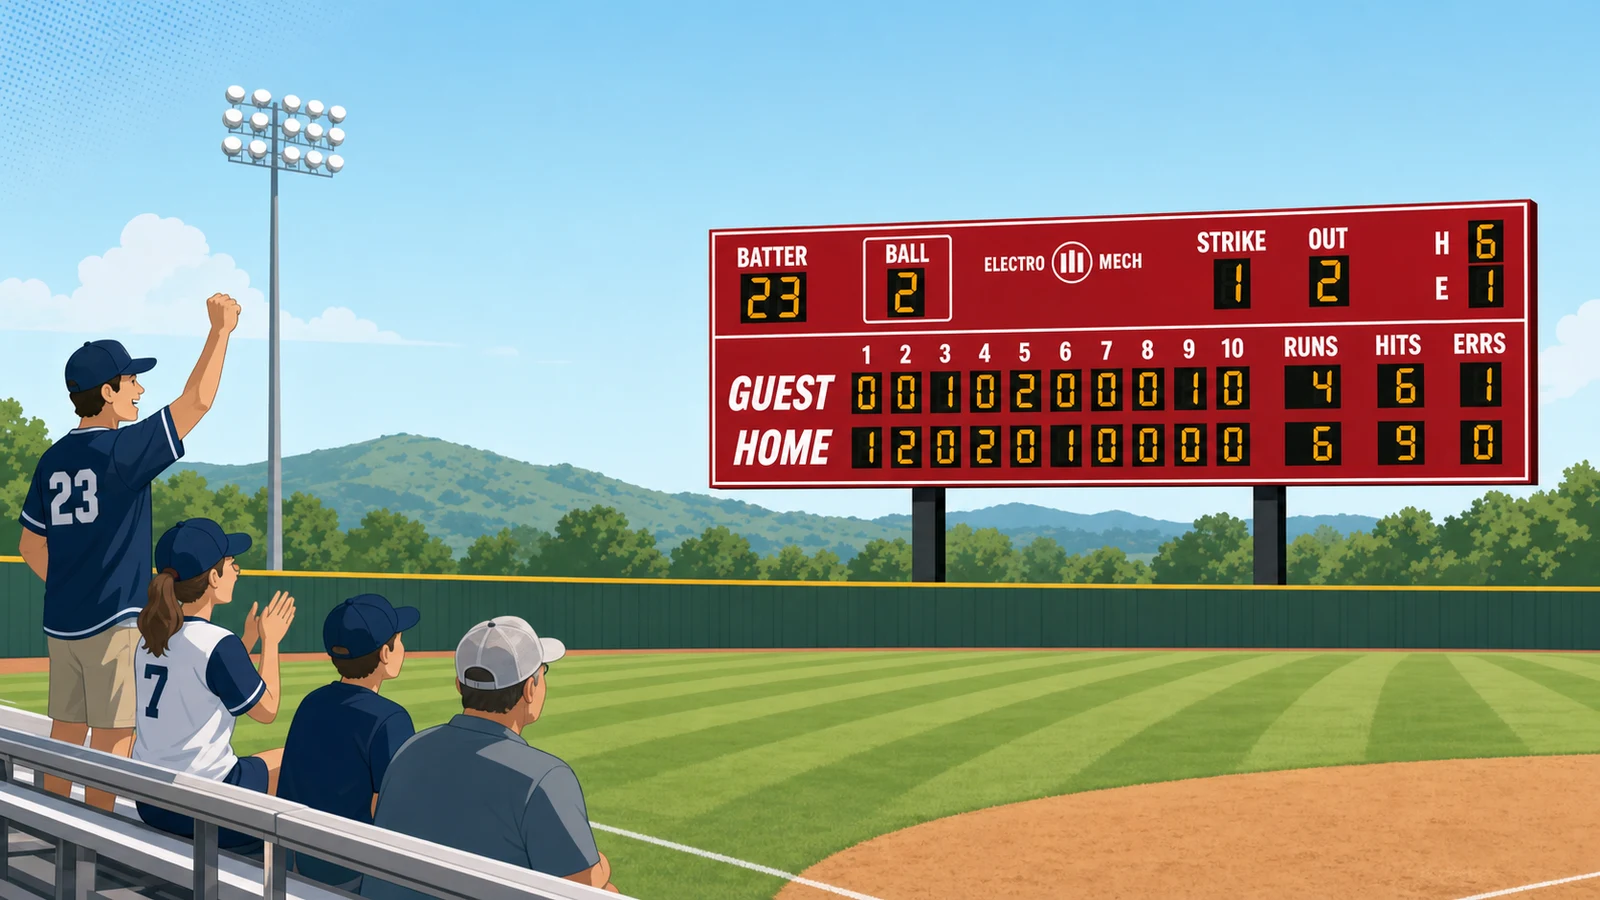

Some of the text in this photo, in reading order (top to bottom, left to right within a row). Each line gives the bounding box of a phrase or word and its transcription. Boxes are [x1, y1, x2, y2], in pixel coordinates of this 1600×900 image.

[886, 243, 929, 263] BALL
[1197, 230, 1266, 253] STRIKE
[1309, 227, 1348, 249] OUT
[1436, 224, 1495, 258] H 6
[738, 246, 807, 267] BATTER
[985, 253, 1141, 272] ELECTRO MECH
[748, 277, 799, 318] 23
[895, 272, 917, 312] 2
[1235, 264, 1242, 302] 1
[1318, 260, 1340, 301] 2
[1436, 270, 1494, 302] E 1
[863, 332, 1505, 364] 1 2 3 4 5 6 7 8 9 10 RUNS HITS ERRS
[729, 368, 1493, 411] GUEST 0 0 1 0 2 0 0 0 1 0 4 6 1
[734, 425, 1493, 466] HOME 1 2 0 2 0 1 0 0 0 0 6 9 0
[49, 468, 98, 525] 23
[144, 664, 168, 718] 7
